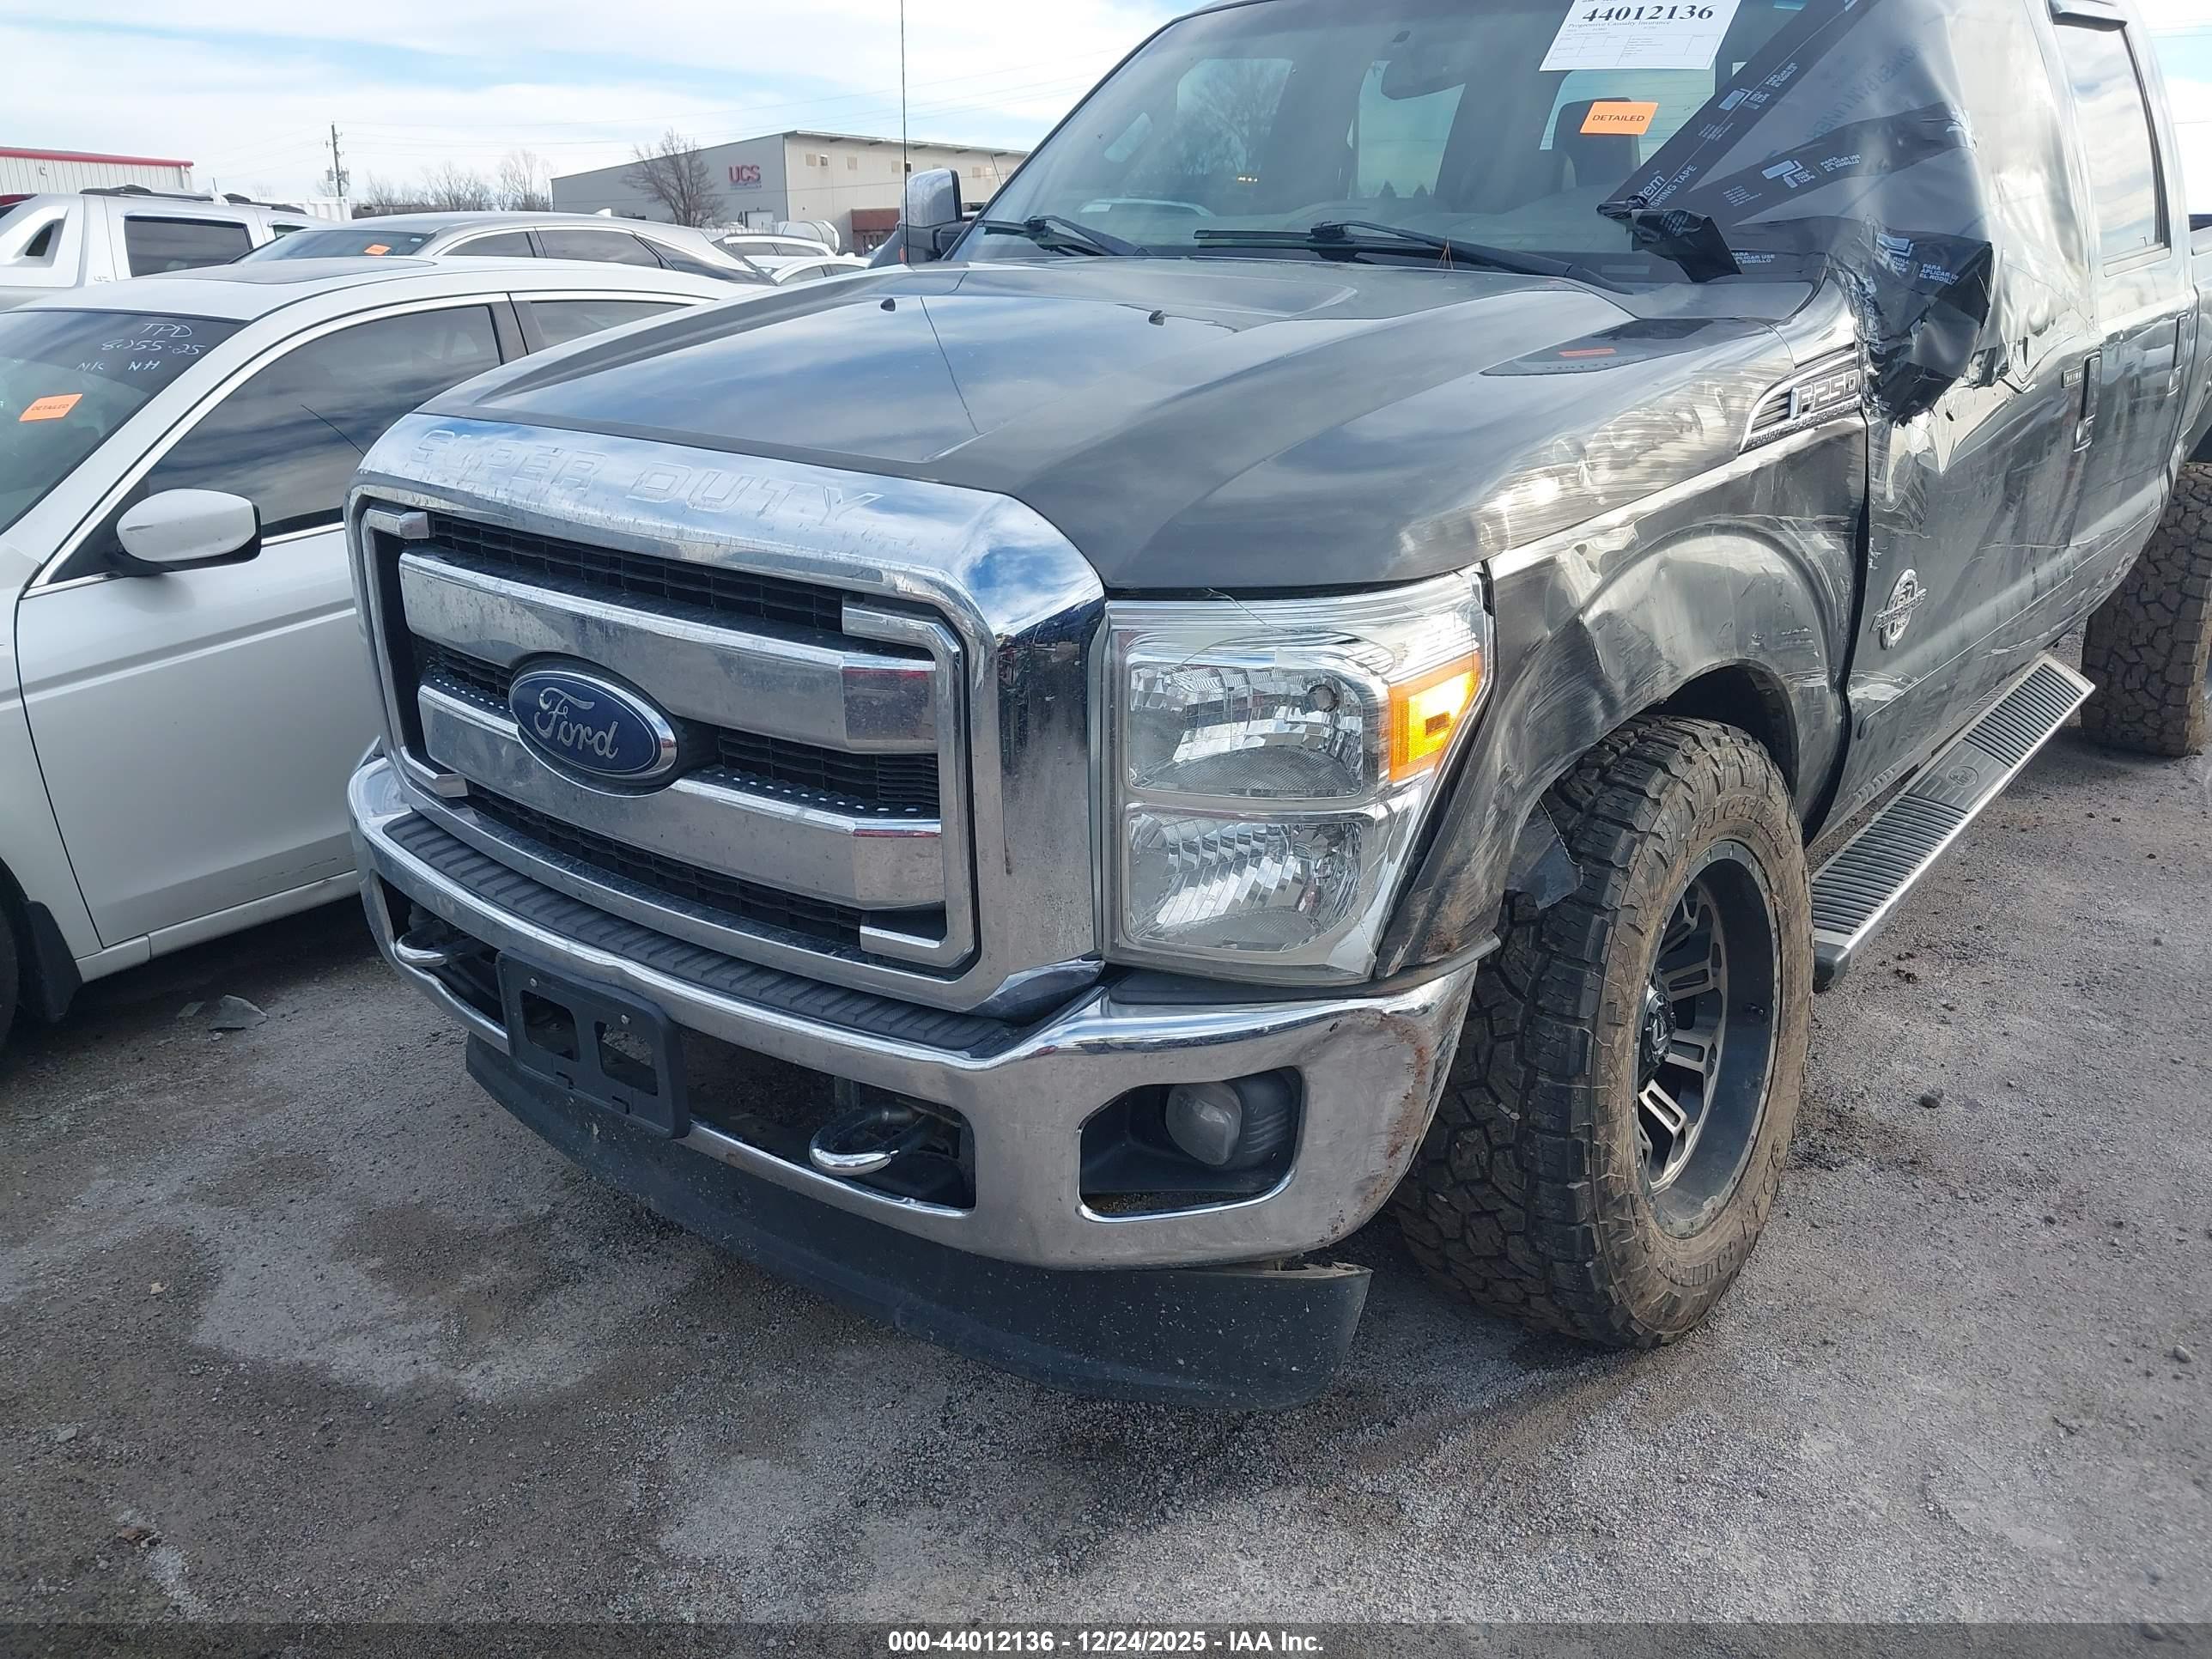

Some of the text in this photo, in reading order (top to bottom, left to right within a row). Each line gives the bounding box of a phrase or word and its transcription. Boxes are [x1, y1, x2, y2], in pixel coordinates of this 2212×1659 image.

[1583, 5, 1716, 21] 44012136
[729, 165, 761, 183] UCS
[1673, 164, 1698, 184] TAPE
[139, 323, 192, 337] TPD
[410, 429, 885, 530] SUPER DUTY
[533, 686, 619, 759] Ford
